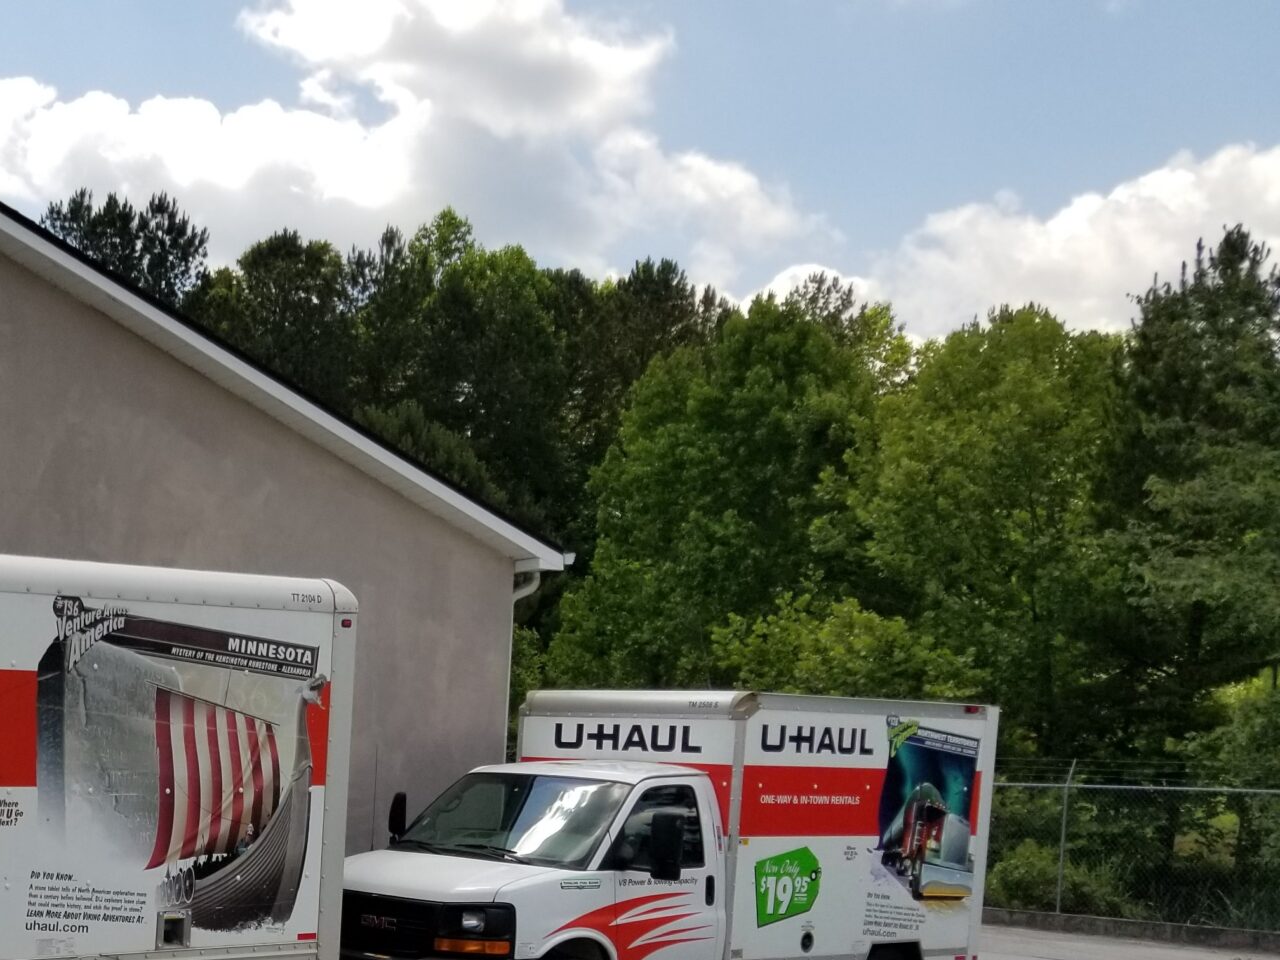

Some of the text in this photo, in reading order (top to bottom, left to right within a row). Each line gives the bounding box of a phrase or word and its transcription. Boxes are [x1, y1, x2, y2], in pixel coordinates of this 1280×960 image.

[291, 593, 299, 601] TT
[301, 594, 316, 603] 2104
[57, 607, 101, 641] Venture
[67, 615, 126, 673] America
[228, 637, 312, 664] MINNESOTA
[171, 647, 196, 659] MYSTERY
[196, 651, 204, 659] OF
[205, 652, 215, 661] THE
[554, 722, 703, 754] U-HAUL
[761, 723, 874, 756] U-HAUL
[760, 795, 860, 805] ONE-WAY & IN-TOWN RENTALS
[6, 809, 13, 819] U
[14, 809, 24, 818] Go
[619, 879, 627, 887] V8
[628, 878, 646, 886] Power
[647, 877, 652, 886] &
[25, 920, 89, 933] uhaul.com
[862, 928, 897, 938] uhaul.com
